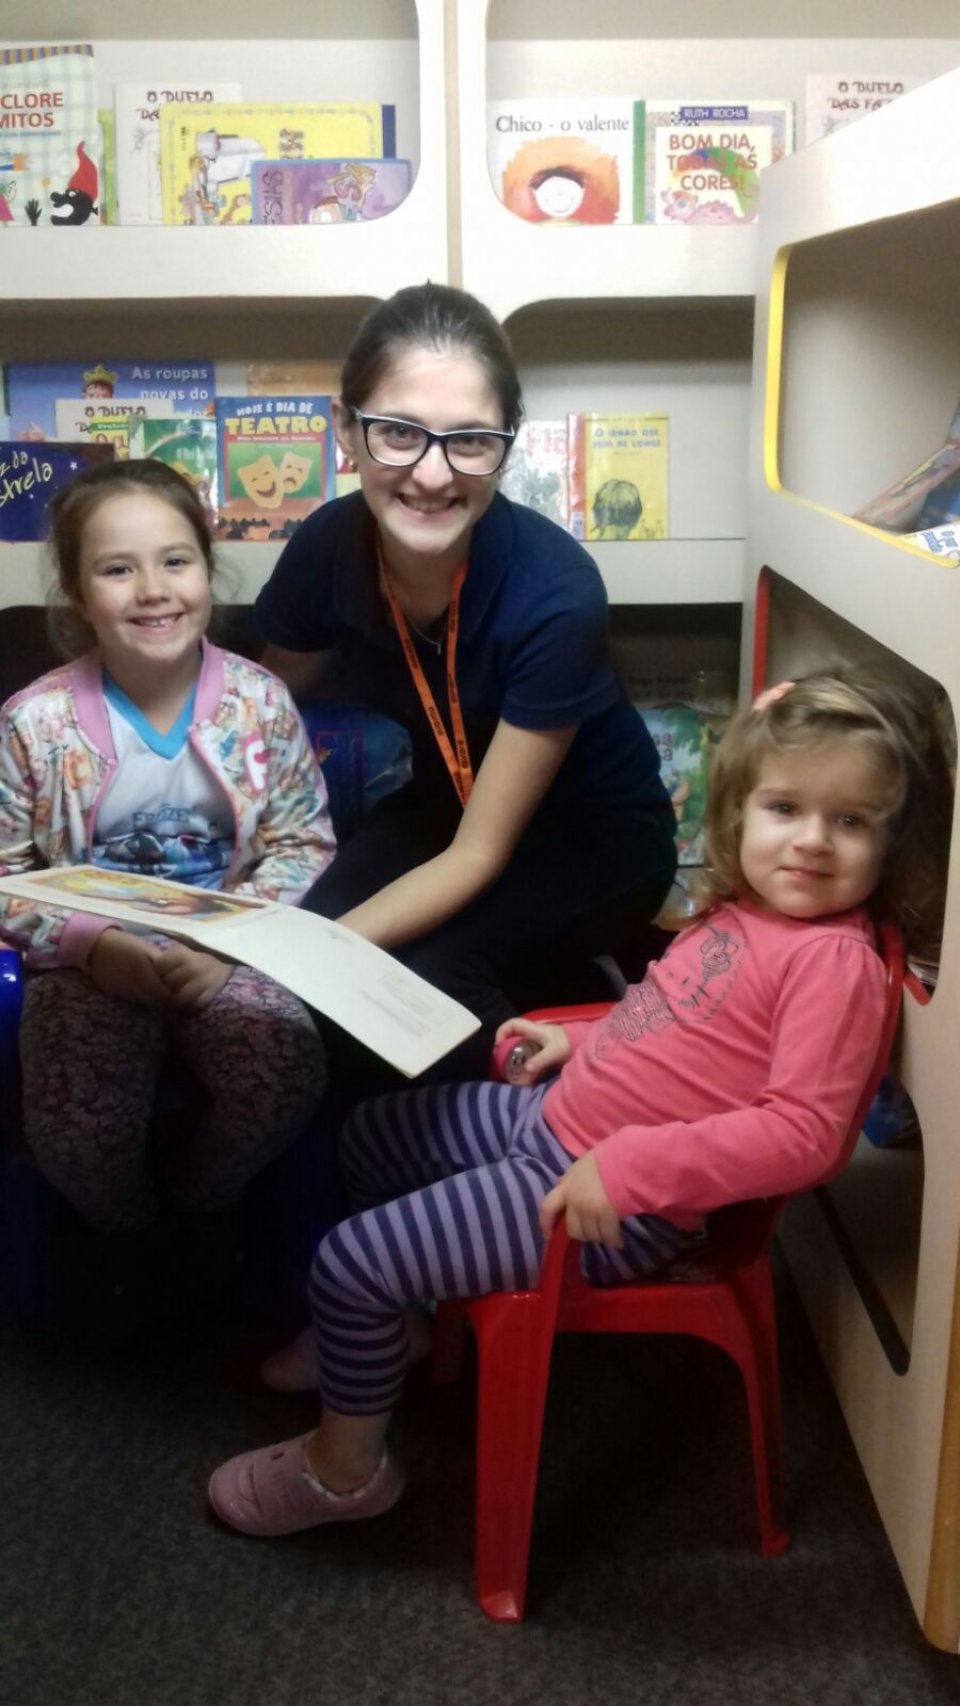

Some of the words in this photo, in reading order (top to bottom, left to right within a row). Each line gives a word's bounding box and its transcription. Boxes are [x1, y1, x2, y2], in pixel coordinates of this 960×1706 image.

[838, 81, 849, 93] O
[851, 81, 904, 94] DUELO
[1, 92, 64, 109] CLORE
[146, 90, 157, 102] O
[160, 90, 214, 103] DUELO
[684, 108, 709, 118] RUTH
[713, 108, 746, 118] ROCHA
[495, 115, 542, 133] Chico
[560, 120, 571, 131] o
[577, 115, 630, 131] valente
[669, 134, 712, 150] BOM
[720, 133, 756, 152] DIA,
[734, 153, 757, 171] AS
[132, 367, 150, 379] As
[156, 367, 208, 381] roupas
[140, 390, 185, 400] novas
[190, 387, 208, 400] do
[85, 406, 94, 417] O
[276, 402, 296, 413] DIA
[299, 402, 315, 414] DE
[224, 415, 327, 435] TEATRO
